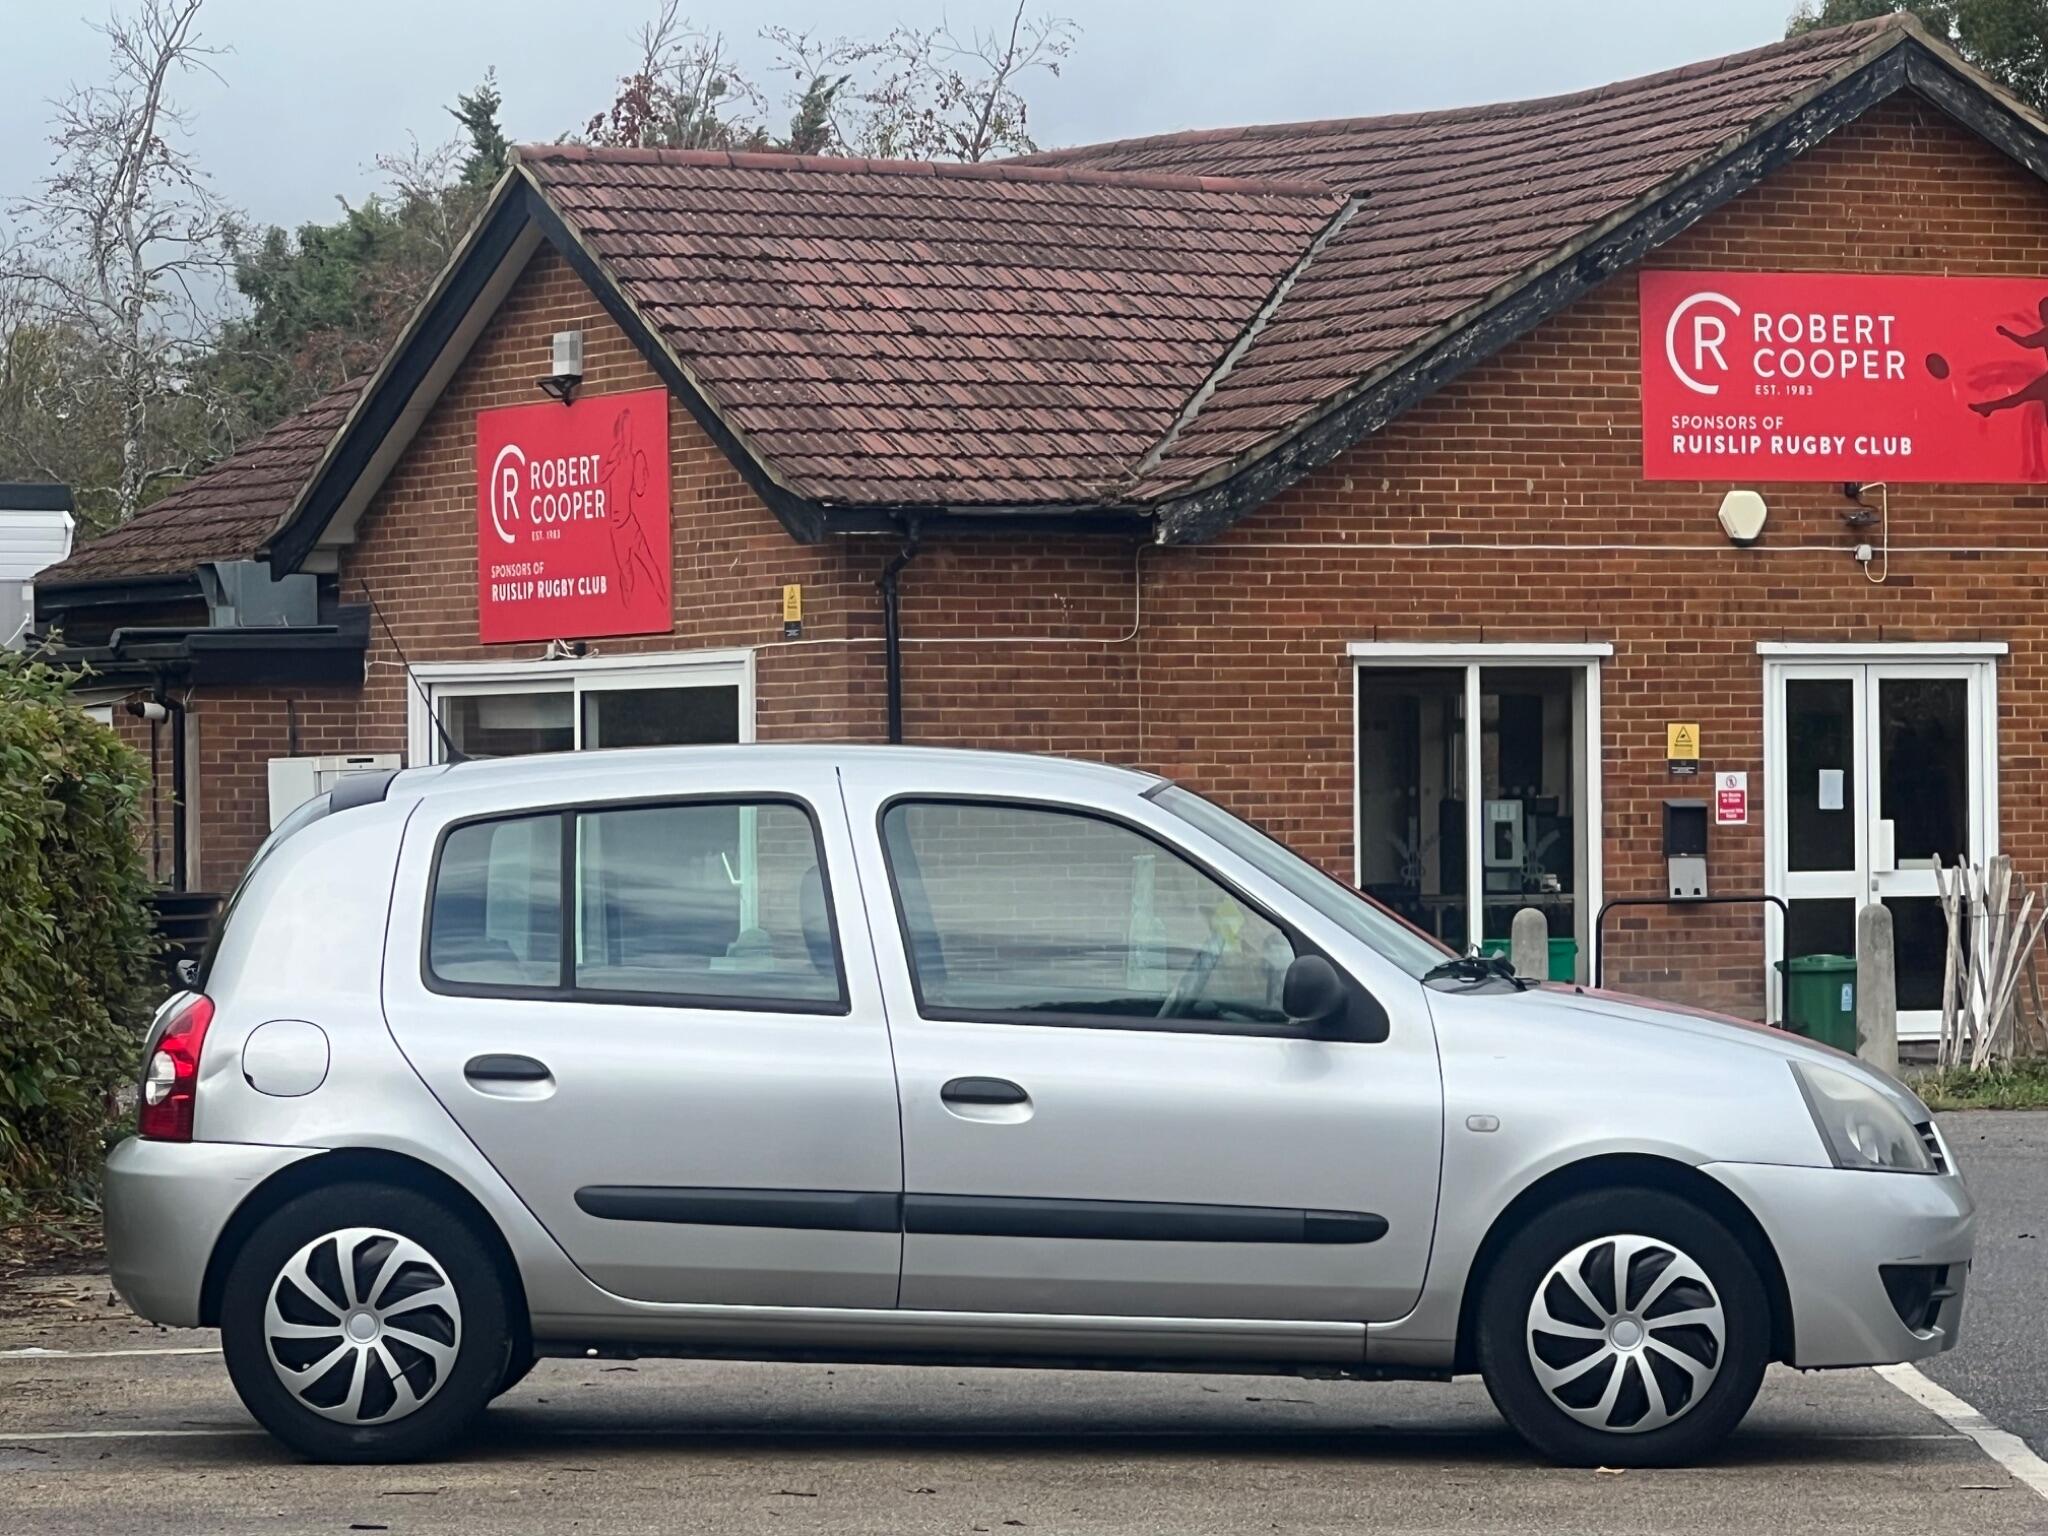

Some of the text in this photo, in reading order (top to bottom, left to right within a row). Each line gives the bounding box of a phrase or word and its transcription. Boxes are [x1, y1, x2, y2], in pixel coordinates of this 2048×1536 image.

[1753, 313, 1896, 345] ROBERT
[1753, 348, 1906, 380] COOPER
[1755, 384, 1813, 396] EST. 1983
[1671, 415, 1784, 430] SPONSORS OF
[1673, 434, 1912, 456] RUISLIP RUGBY CLUB
[530, 455, 600, 490] ROBERT
[530, 489, 606, 525] COOPER
[491, 561, 545, 579] SPONSORS OF
[491, 575, 607, 602] RUISLIP RUGBY CLUB
